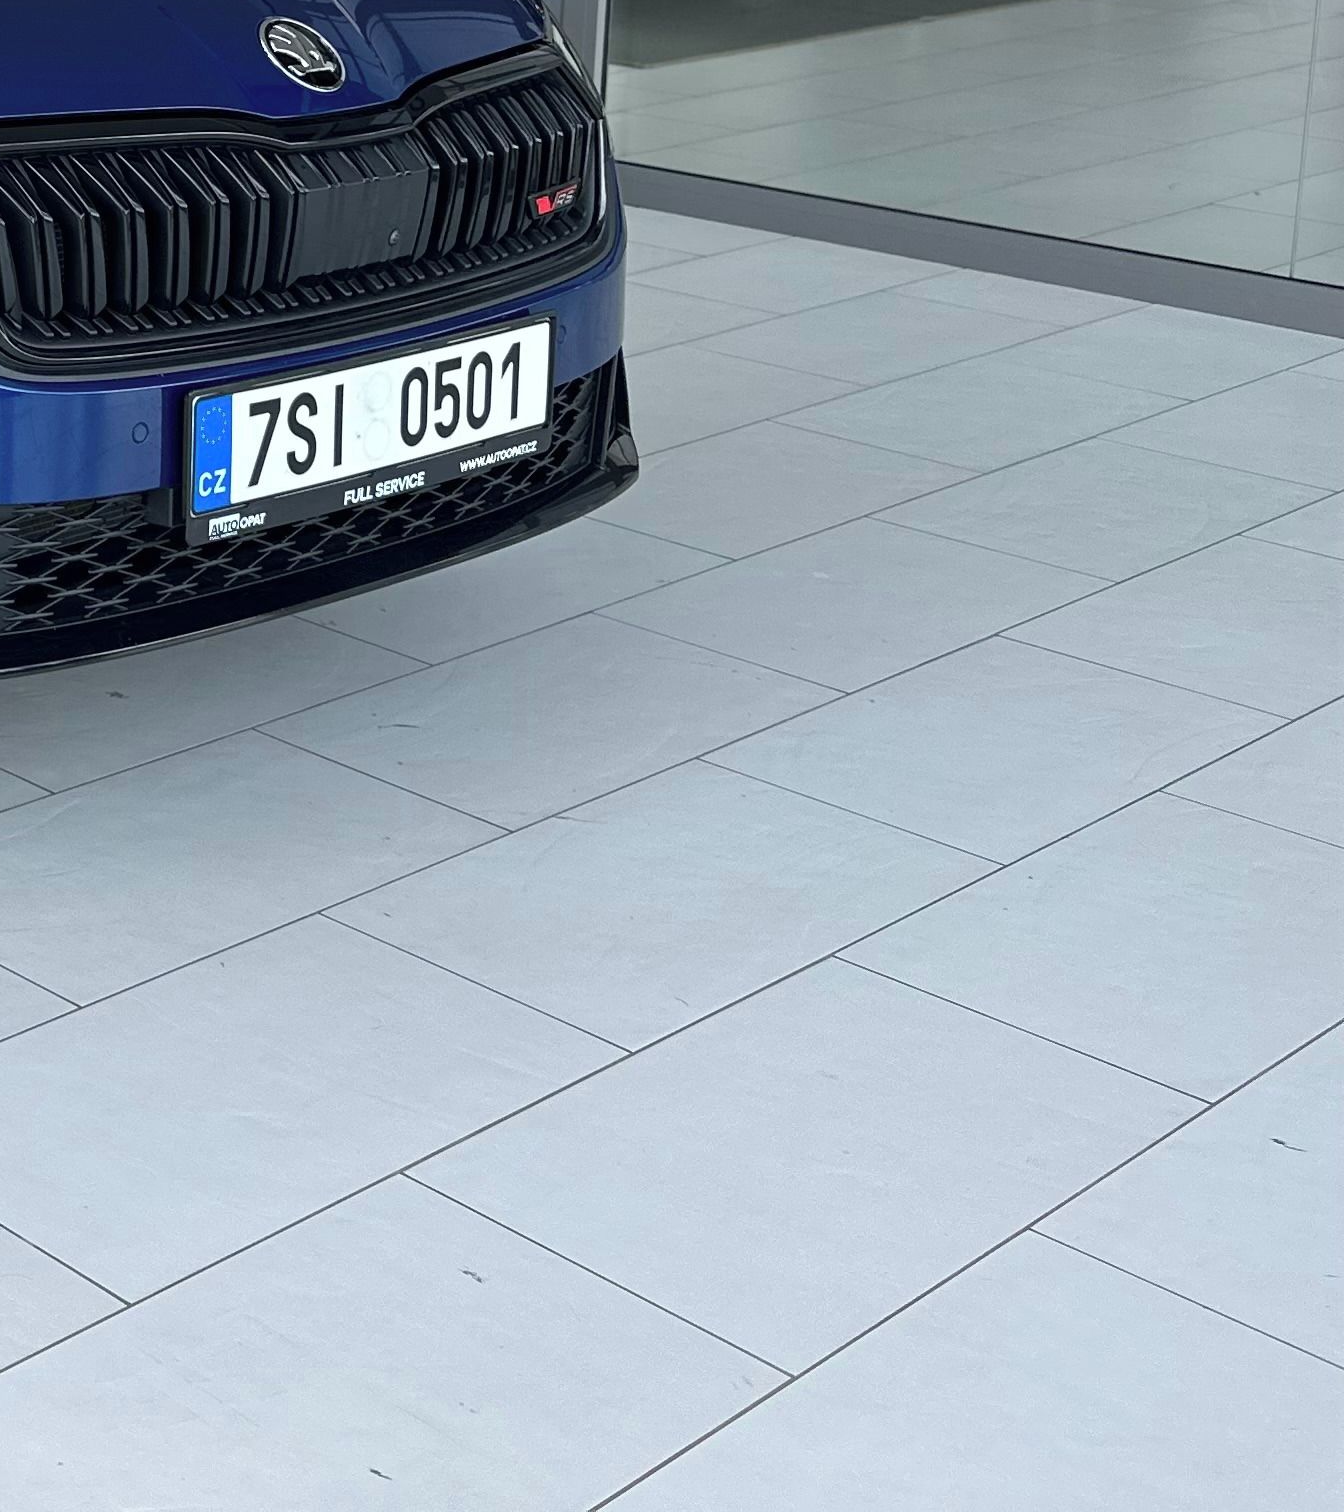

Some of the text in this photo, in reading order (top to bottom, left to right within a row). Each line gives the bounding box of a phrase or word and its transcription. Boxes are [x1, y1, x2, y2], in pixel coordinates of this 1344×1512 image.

[247, 341, 520, 487] 7SI 0501
[199, 469, 226, 497] CZ
[343, 471, 425, 505] FULL SERVICE
